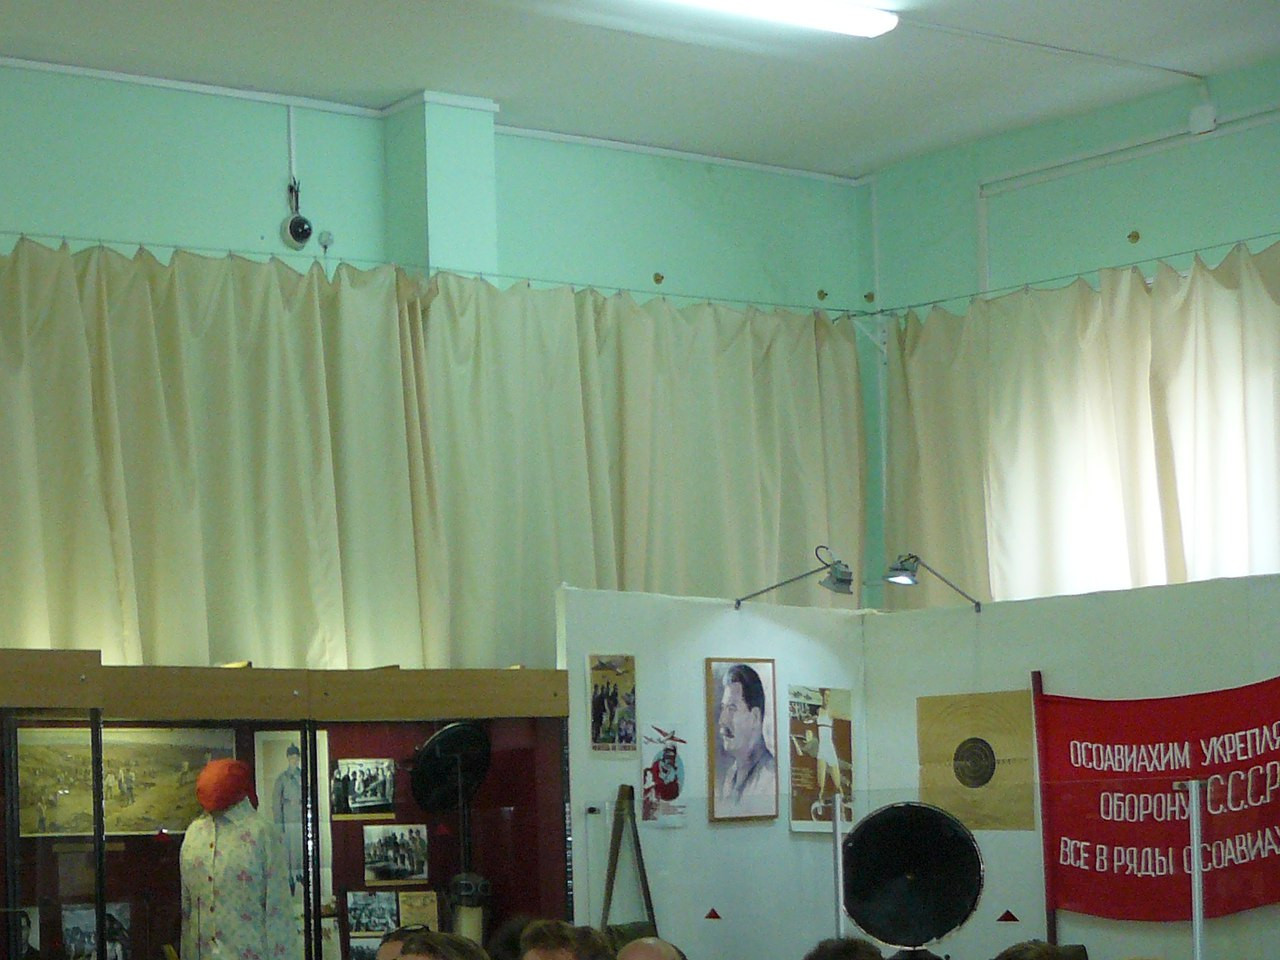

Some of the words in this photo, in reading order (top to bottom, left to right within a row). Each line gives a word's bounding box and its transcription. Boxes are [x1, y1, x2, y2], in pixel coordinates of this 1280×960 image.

[1070, 740, 1191, 772] ОСОАВИАХИМ
[1100, 791, 1191, 822] ОБОРОНУ
[1059, 836, 1090, 870] ВСЕ
[1095, 844, 1108, 872] В
[1113, 846, 1174, 877] РЯДЫ
